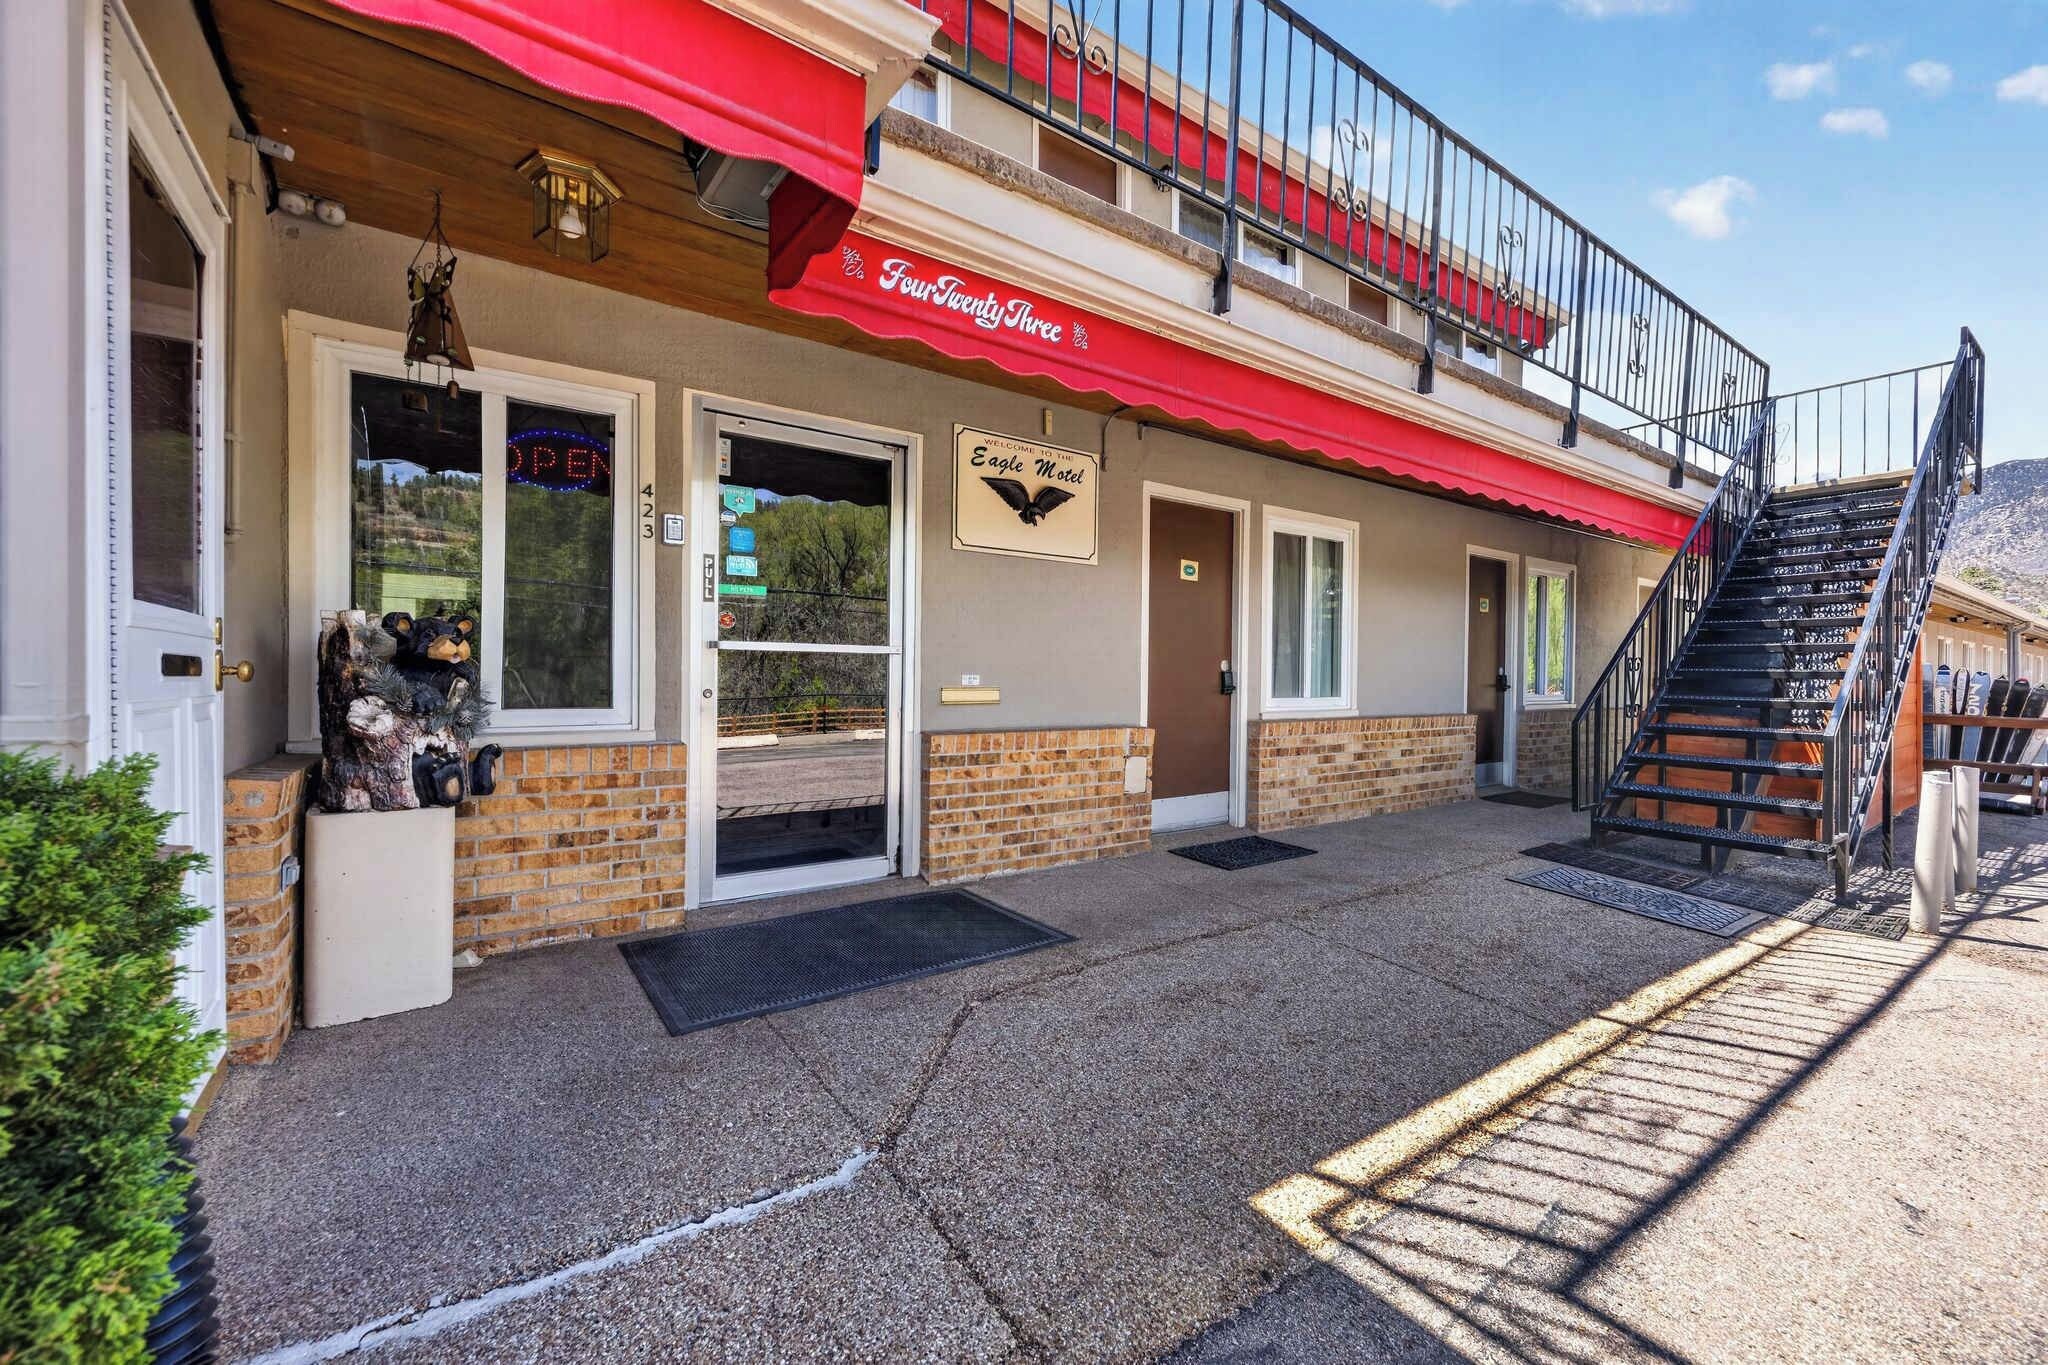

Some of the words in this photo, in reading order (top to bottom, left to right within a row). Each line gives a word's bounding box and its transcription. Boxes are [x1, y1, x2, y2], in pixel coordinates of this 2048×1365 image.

[970, 446, 1024, 475] Eagle
[1035, 459, 1085, 484] Motel
[983, 438, 1035, 455] WELCOME
[704, 557, 713, 599] PULL
